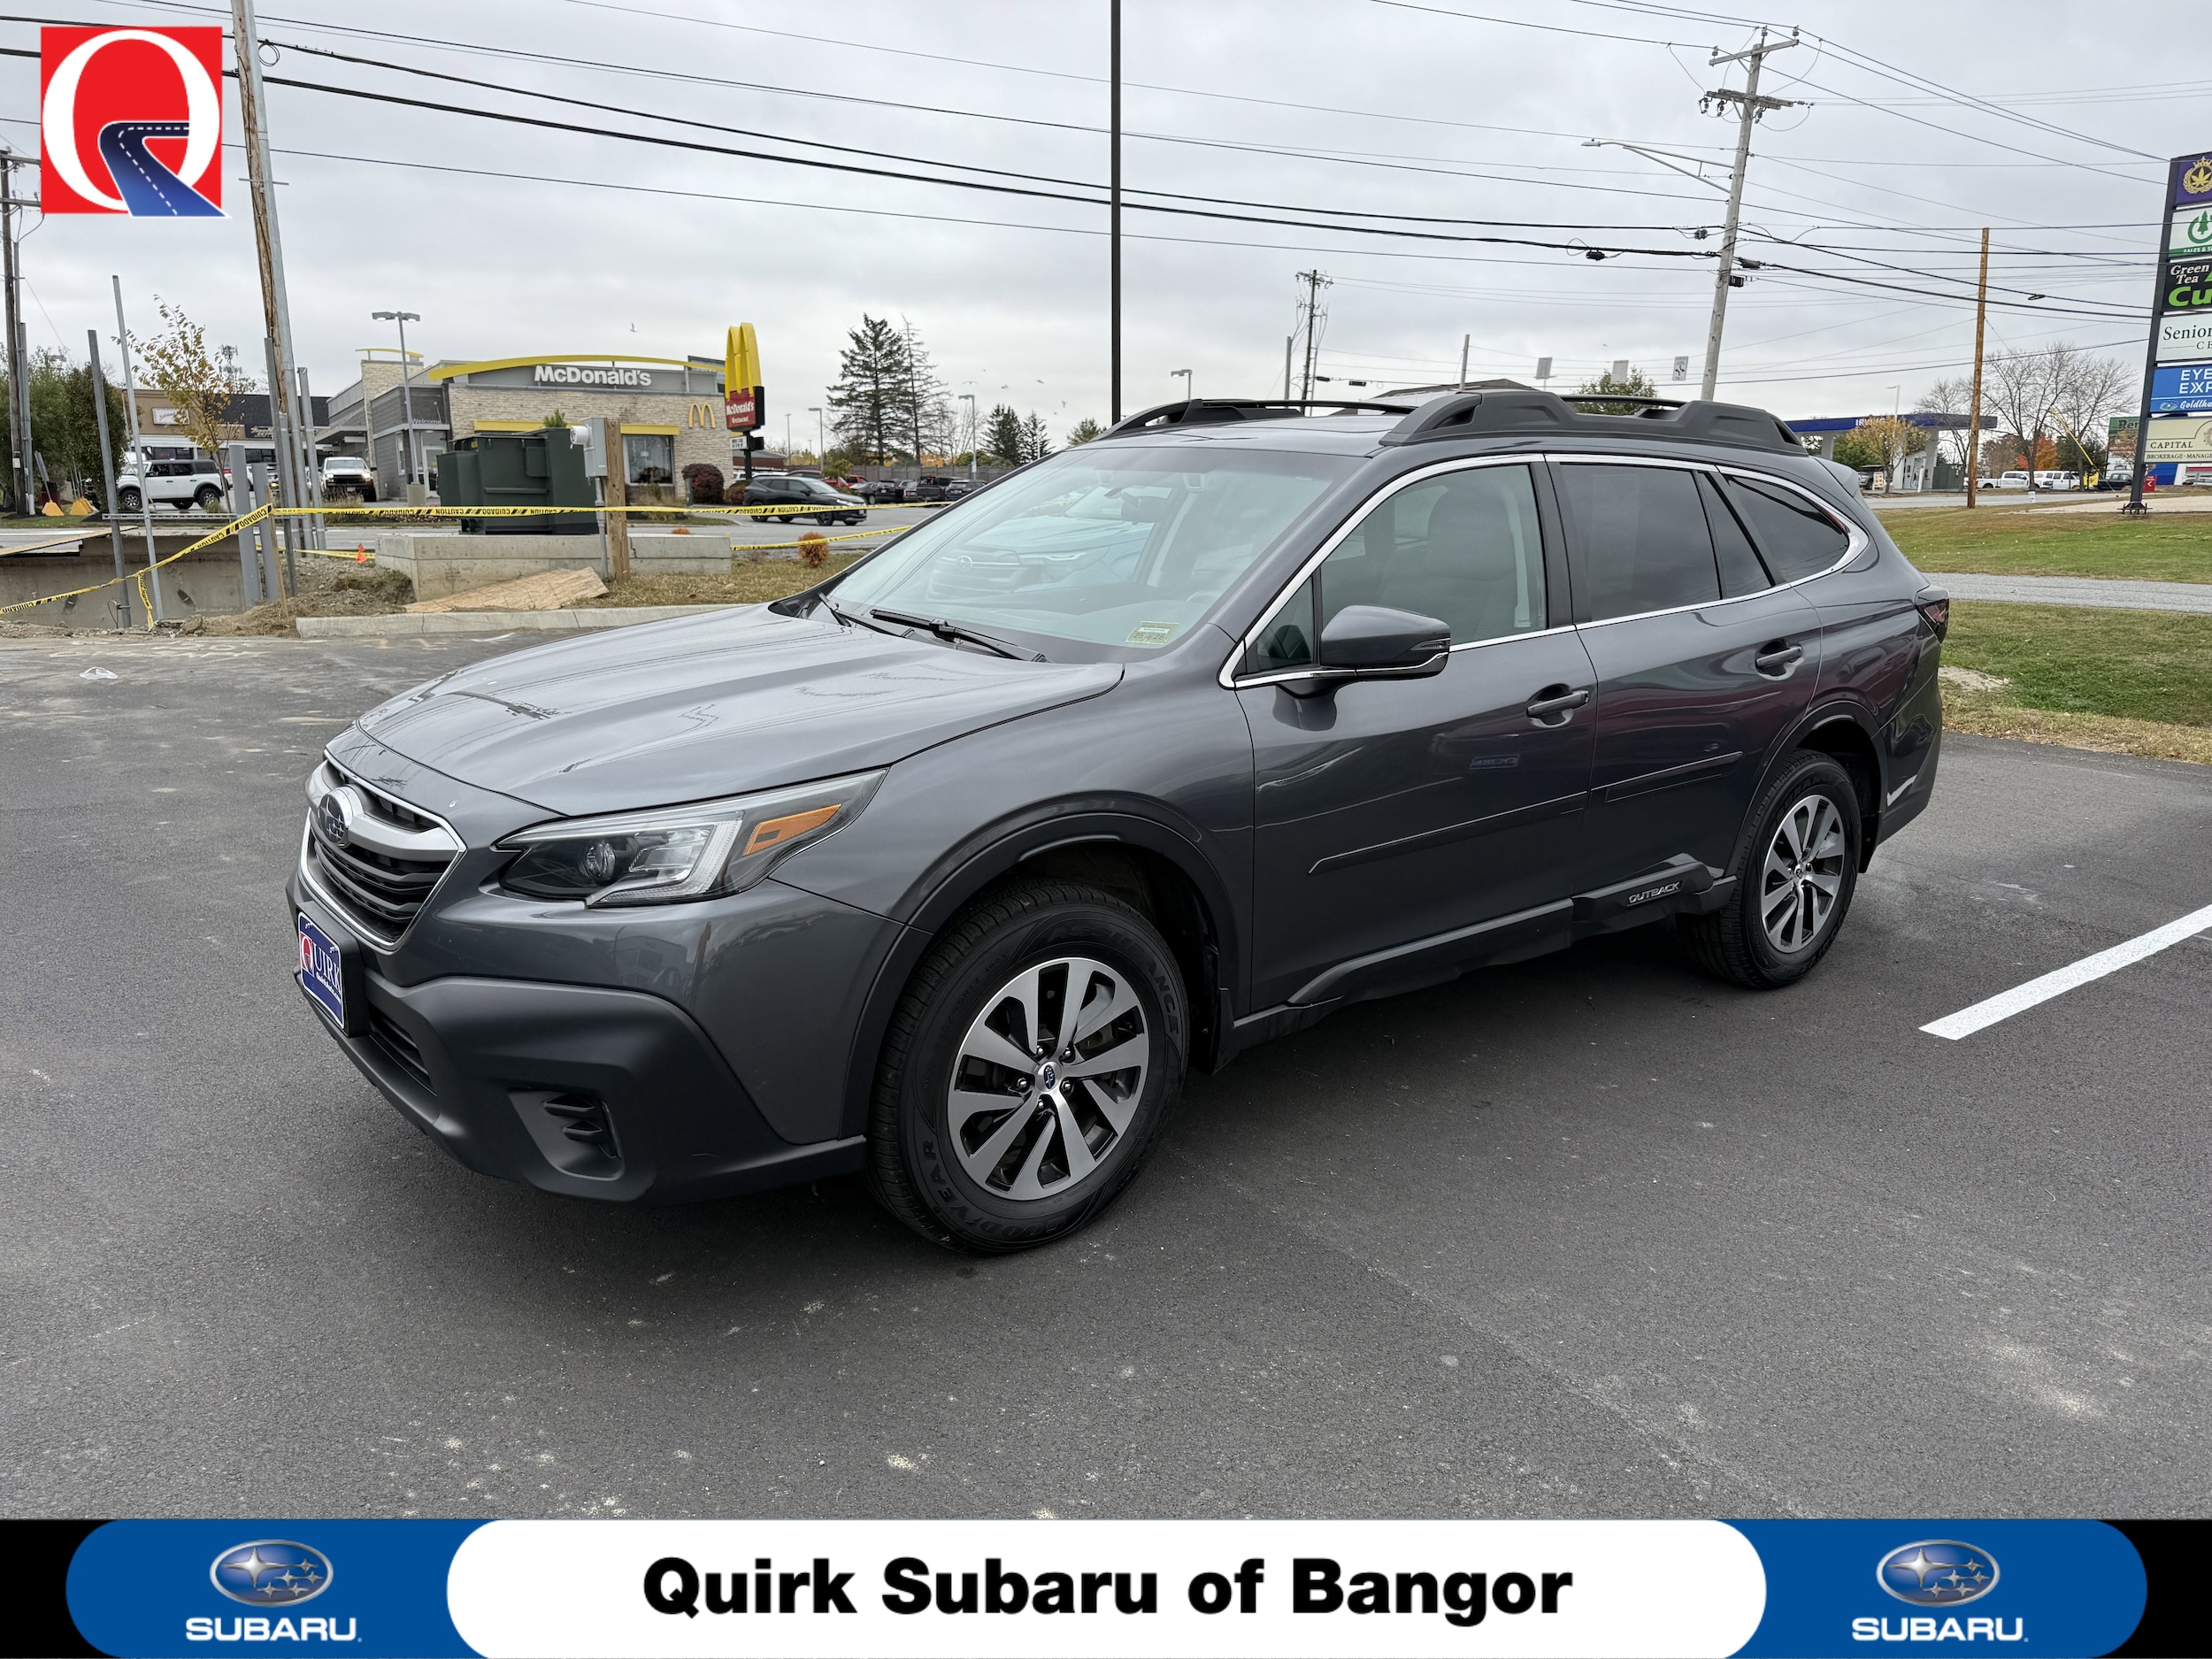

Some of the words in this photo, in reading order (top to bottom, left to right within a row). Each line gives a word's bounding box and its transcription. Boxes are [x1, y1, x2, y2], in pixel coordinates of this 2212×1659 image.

[2170, 265, 2210, 276] Green
[2177, 274, 2199, 285] Tea
[534, 365, 652, 387] McDonald's
[726, 402, 754, 416] McDonald's
[239, 509, 267, 528] CUIDADO
[1628, 881, 1680, 903] OUTBACK
[922, 1139, 1066, 1238] GOODYEAR
